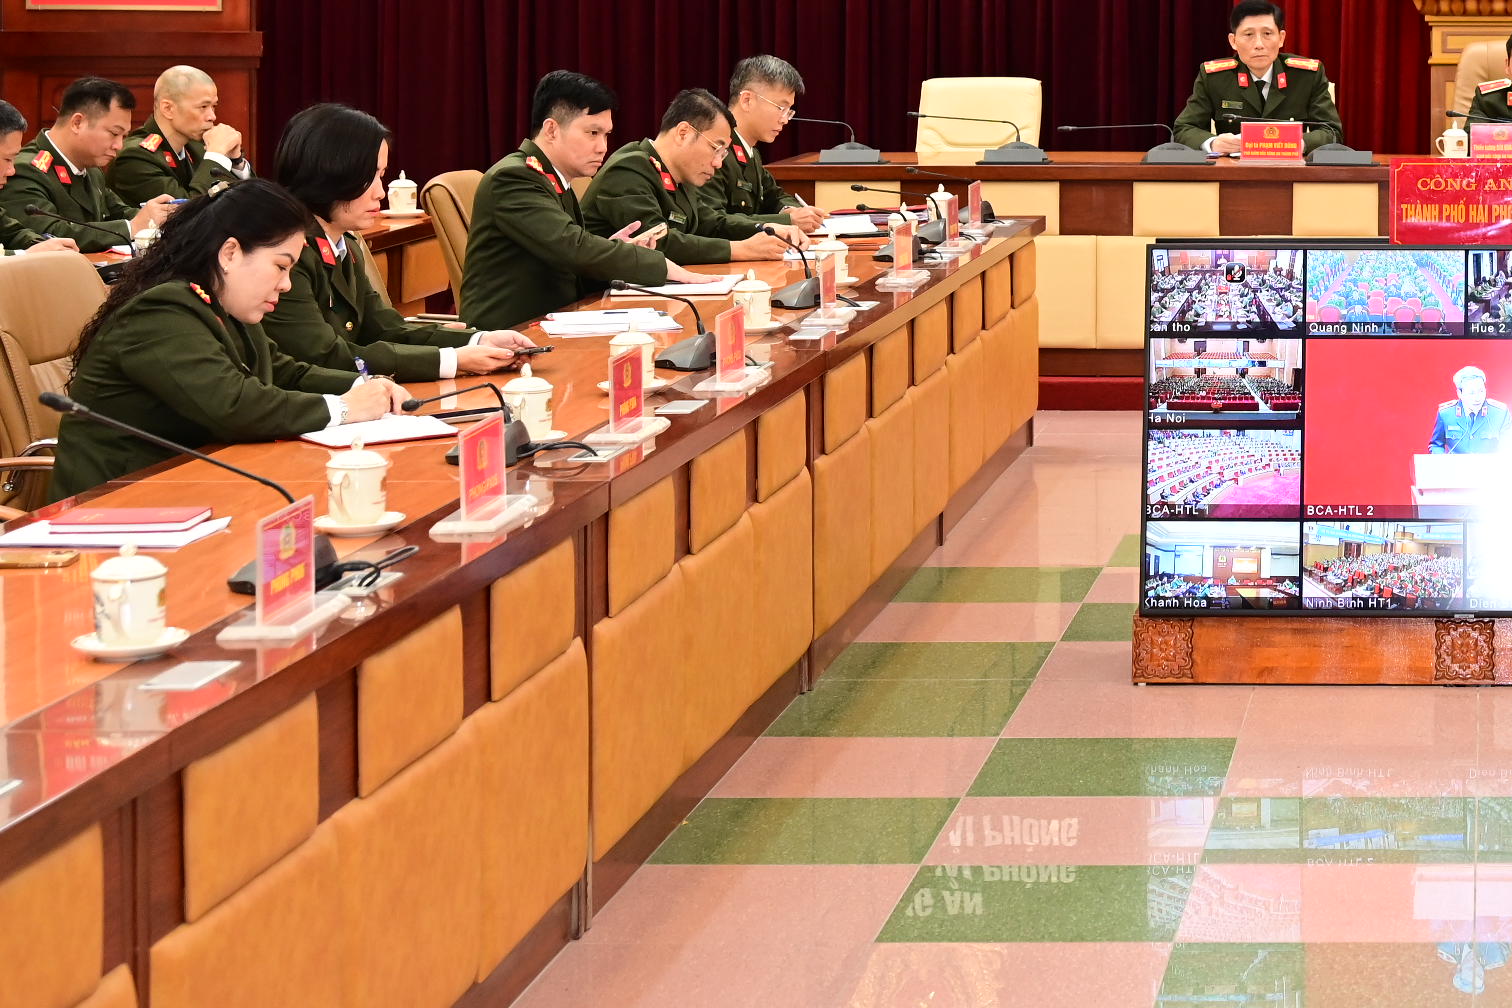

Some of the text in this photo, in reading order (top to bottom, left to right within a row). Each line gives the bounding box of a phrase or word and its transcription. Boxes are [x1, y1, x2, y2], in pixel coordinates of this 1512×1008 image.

[1417, 174, 1477, 191] CÔNG
[1401, 199, 1439, 223] THÀNH
[1443, 197, 1465, 223] PHỐ
[1172, 322, 1191, 332] tho
[1309, 323, 1379, 334] Quang Ninh
[1471, 323, 1506, 333] Hue 2
[1166, 413, 1186, 423] Noi
[1205, 505, 1209, 515] 1
[1307, 505, 1374, 516] BCA-HTL 2
[1184, 598, 1207, 608] Hoa
[1306, 598, 1333, 608] Ninh
[1337, 598, 1364, 608] Binh
